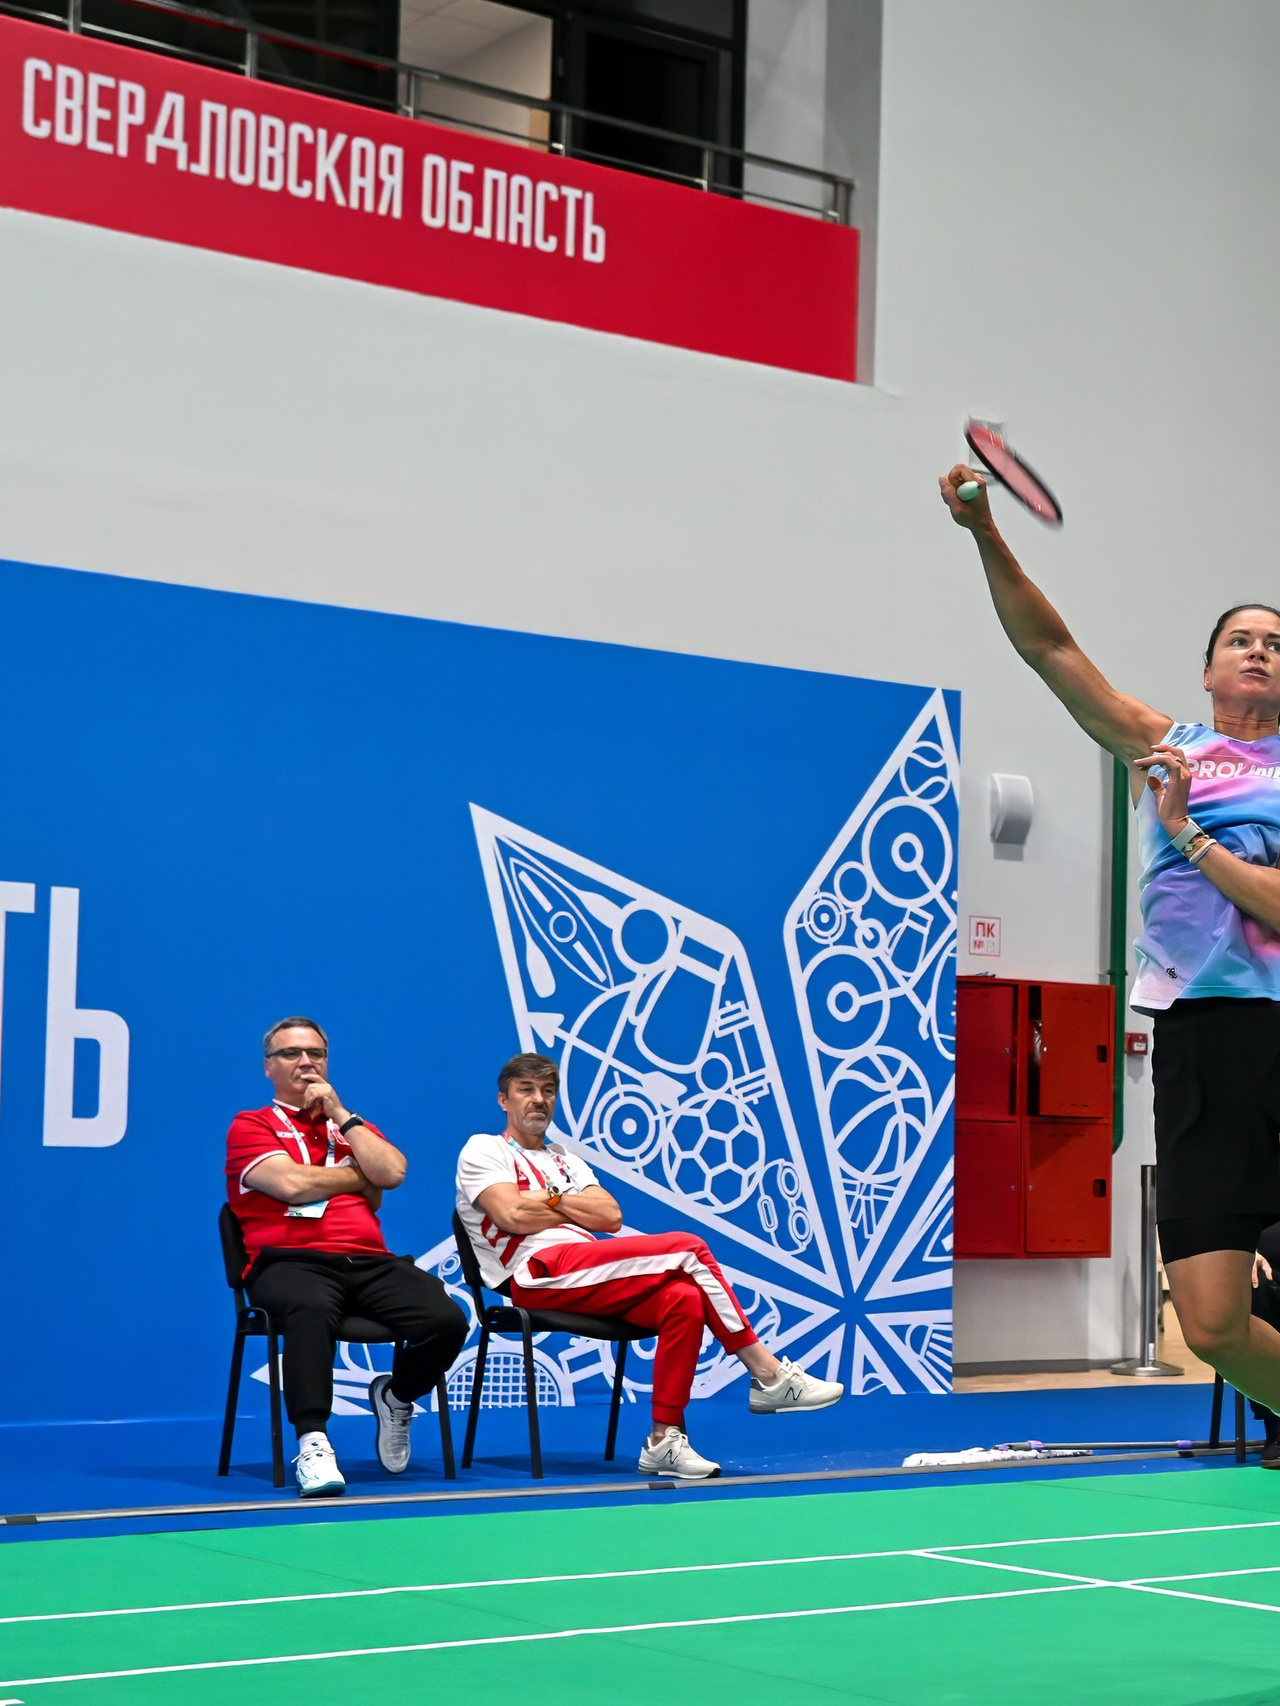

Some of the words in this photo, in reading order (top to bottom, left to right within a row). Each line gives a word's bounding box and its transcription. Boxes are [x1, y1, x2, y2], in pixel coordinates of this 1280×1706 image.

[22, 58, 404, 219] СВЕРДЛОВСКАЯ
[421, 154, 607, 263] ОБЛАСТЬ
[976, 921, 996, 938] ПК
